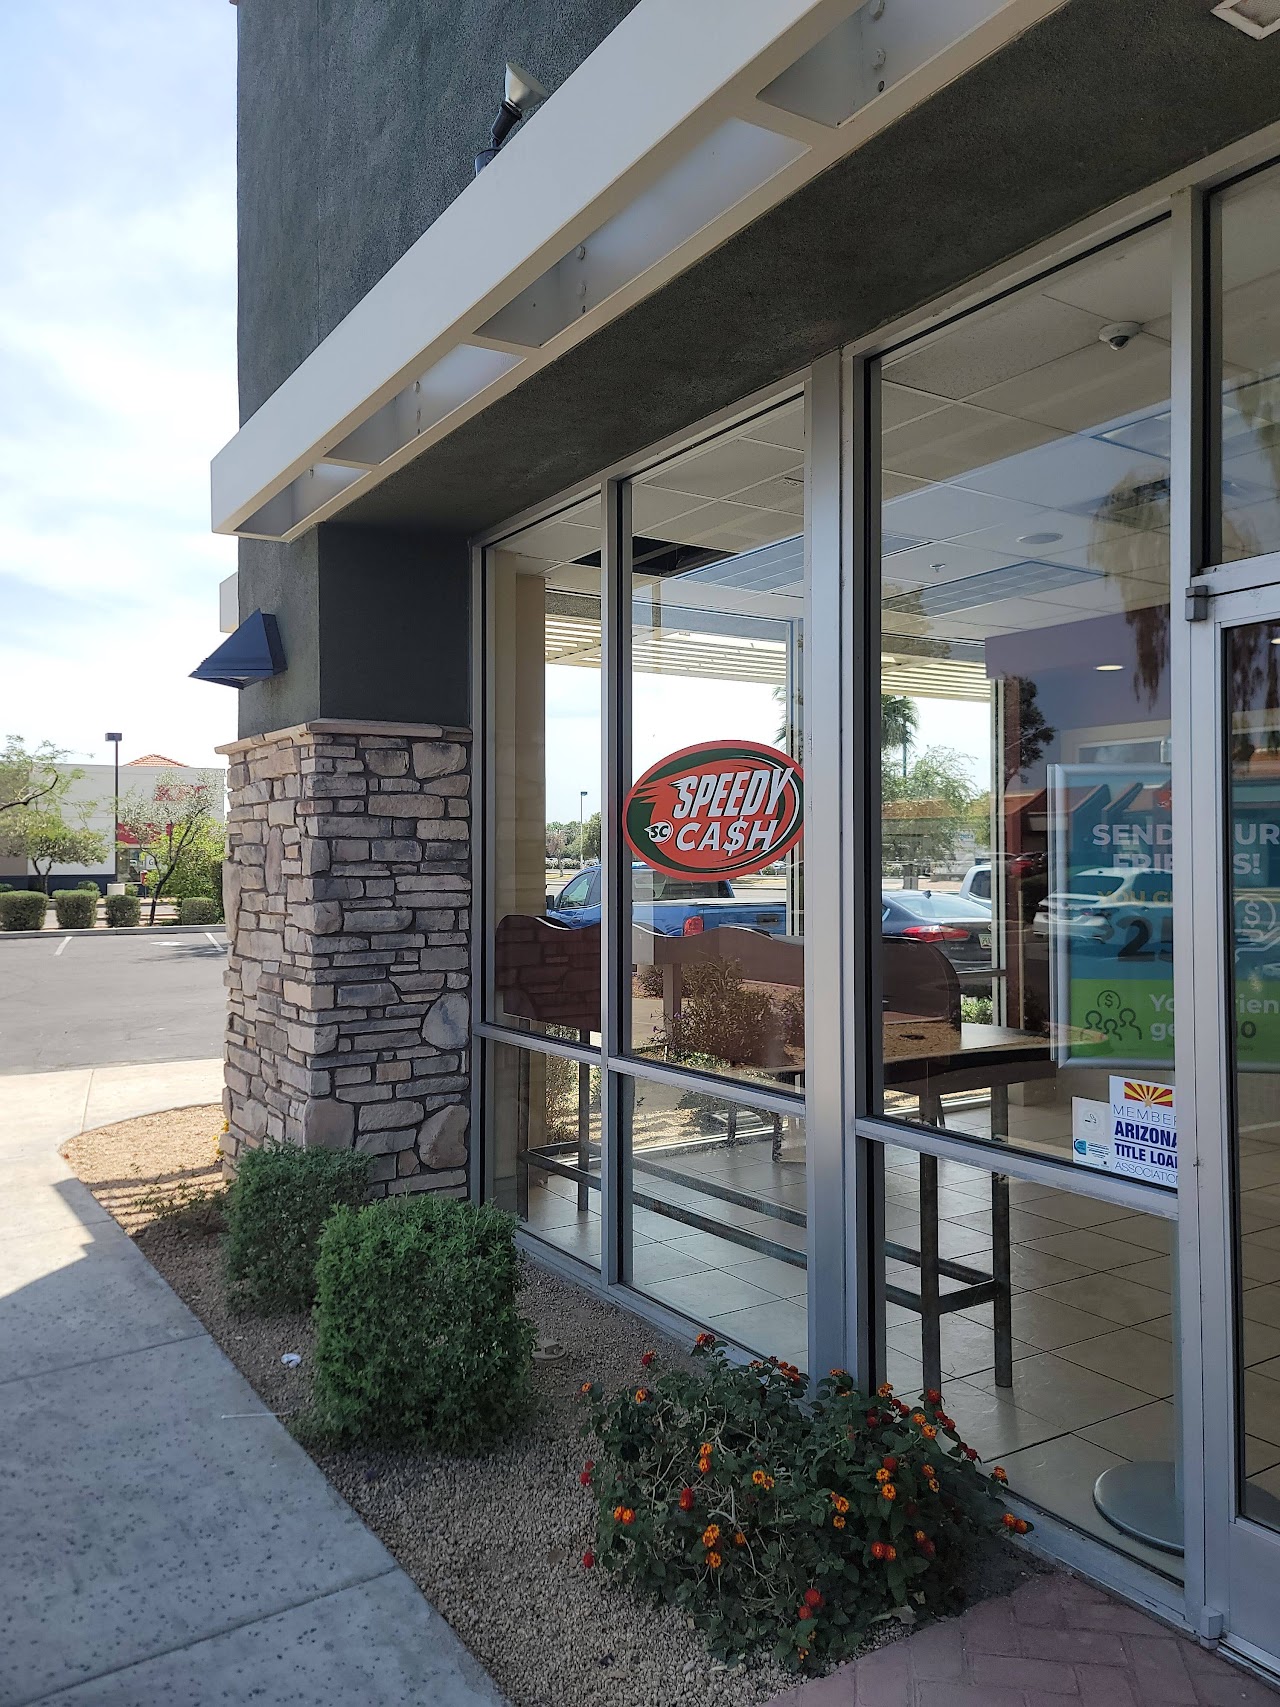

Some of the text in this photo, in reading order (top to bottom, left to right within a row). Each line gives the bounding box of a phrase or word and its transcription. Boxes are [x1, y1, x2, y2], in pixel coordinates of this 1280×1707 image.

[670, 767, 794, 819] SPEEDY
[650, 825, 669, 839] SC
[676, 816, 780, 857] CA$H
[1092, 823, 1280, 846] SEND UR
[1114, 1142, 1146, 1162] TITLE
[1114, 1161, 1178, 1185] ASSOCIATIO
